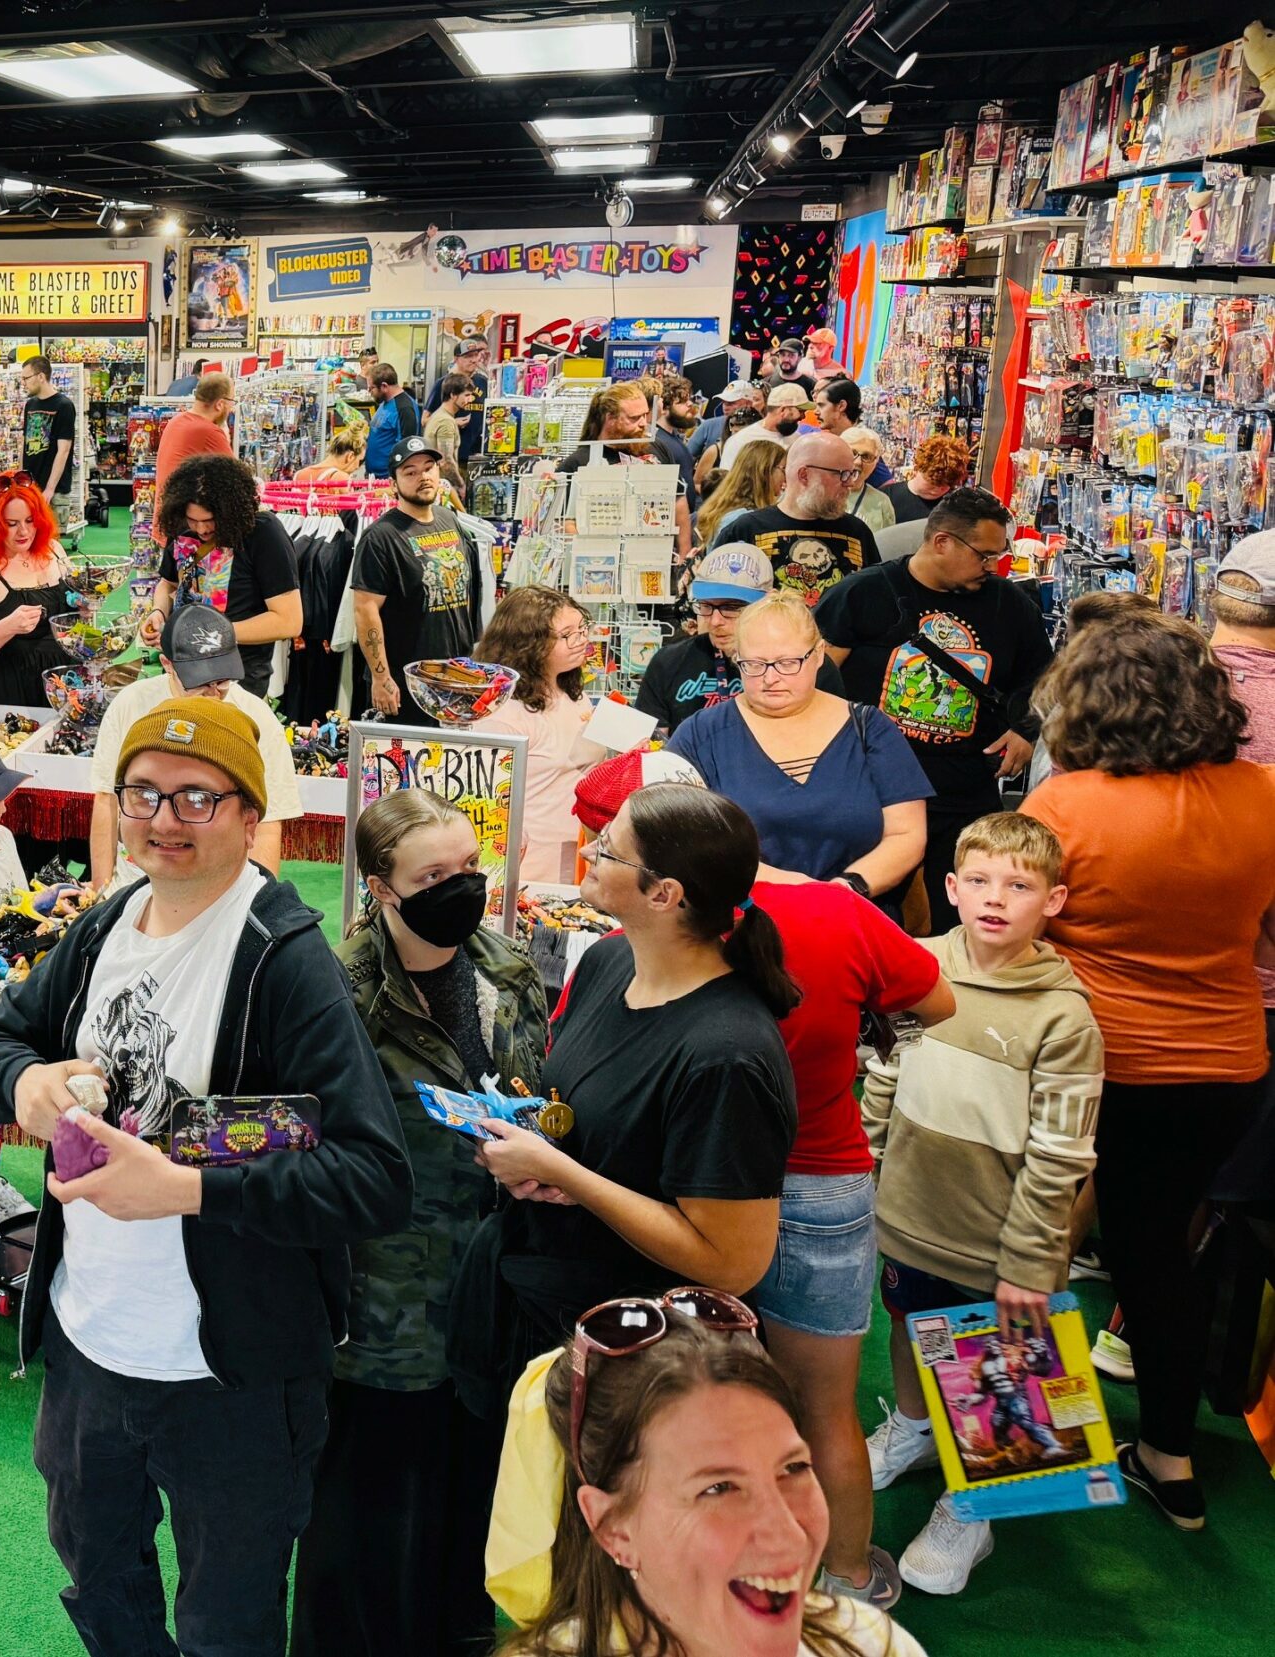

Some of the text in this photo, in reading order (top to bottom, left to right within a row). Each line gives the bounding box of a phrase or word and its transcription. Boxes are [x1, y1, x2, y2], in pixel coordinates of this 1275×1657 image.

[278, 248, 368, 274] BLOCKBUSTER
[469, 242, 689, 275] TIME BLASTER TOYS
[29, 271, 90, 291] BLASTER
[102, 270, 138, 290] TOYS
[329, 269, 361, 285] VIDEO
[28, 295, 63, 314] MEET
[72, 295, 80, 314] &
[90, 294, 134, 314] GREET
[386, 309, 429, 320] phone
[616, 358, 642, 368] MATT
[377, 748, 498, 802] DIG BIN
[486, 823, 502, 831] EACH
[228, 1121, 265, 1135] MONSTER
[236, 1135, 257, 1143] 500
